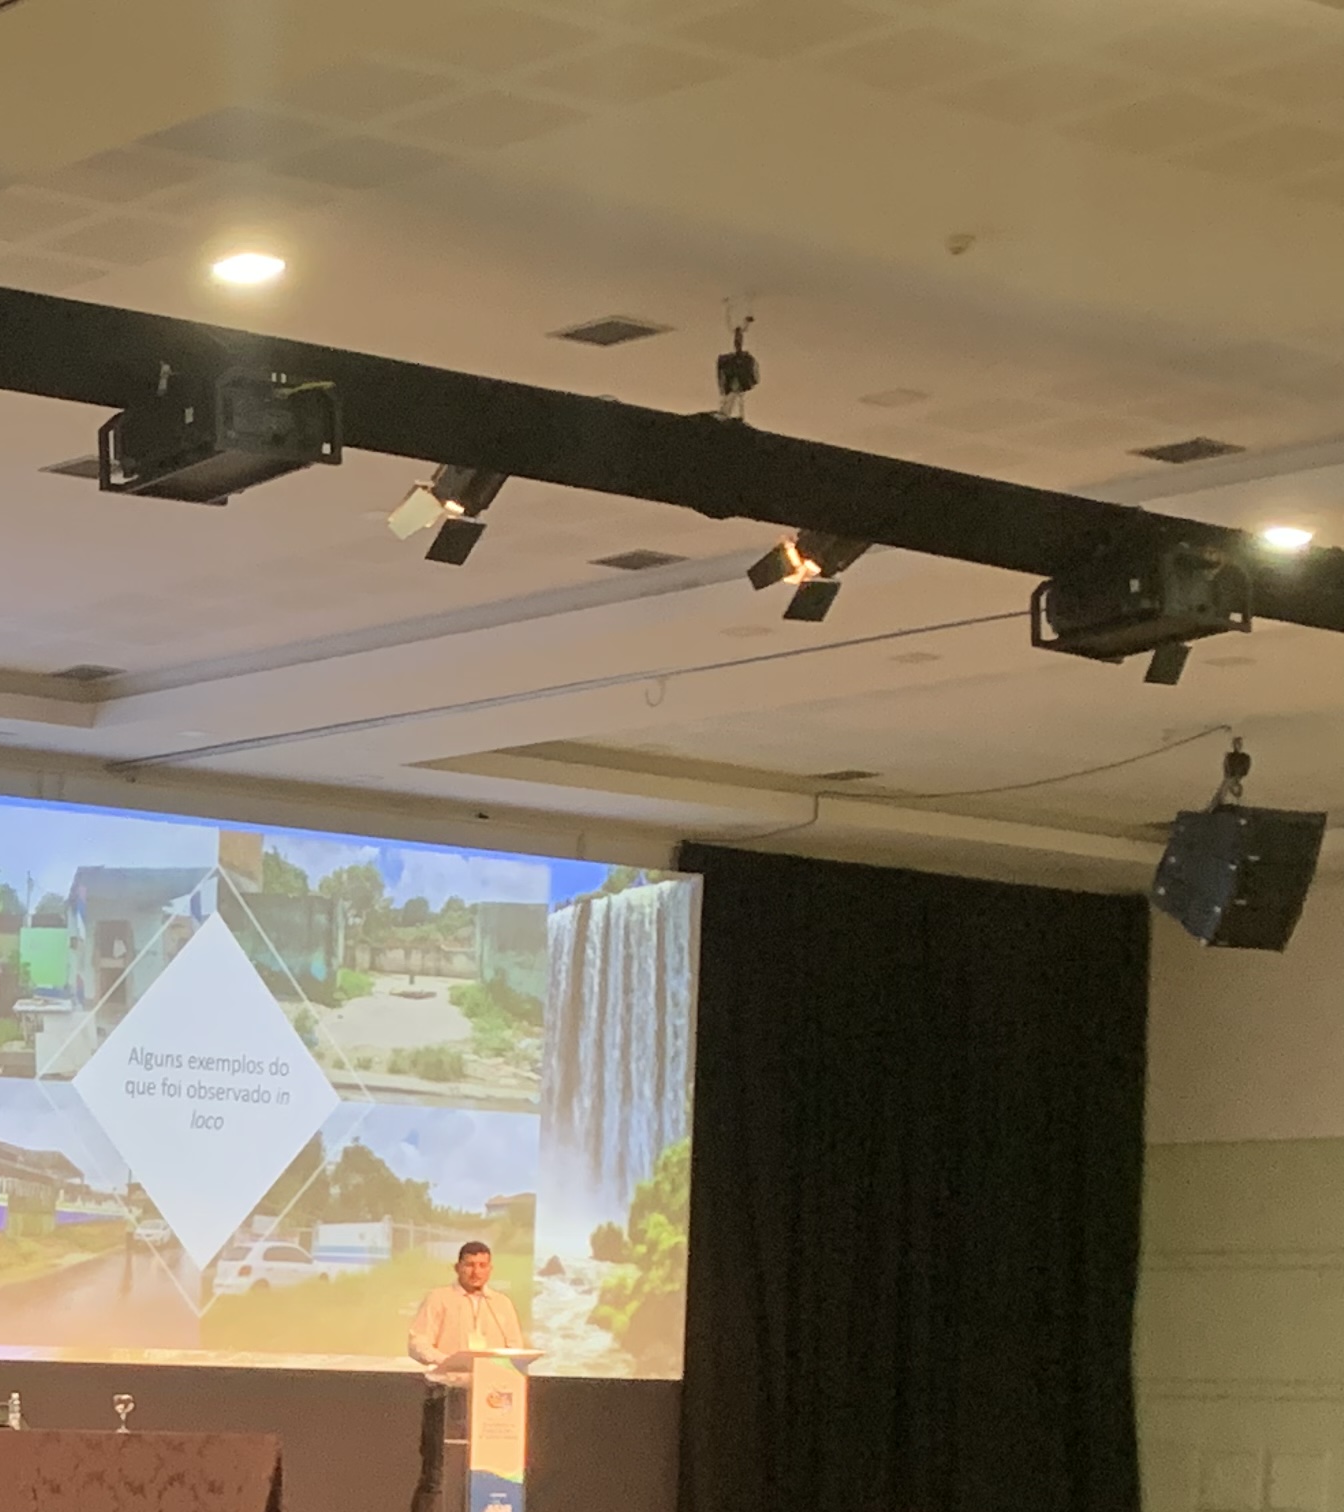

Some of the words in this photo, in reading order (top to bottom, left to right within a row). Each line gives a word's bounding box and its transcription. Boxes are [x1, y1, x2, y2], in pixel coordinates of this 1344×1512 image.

[127, 1046, 183, 1072] Alguns
[187, 1053, 265, 1076] exemplos
[268, 1056, 290, 1078] do
[124, 1079, 157, 1099] que
[161, 1076, 182, 1099] foi
[186, 1079, 272, 1104] observado
[275, 1086, 291, 1106] in
[189, 1108, 225, 1131] loco
